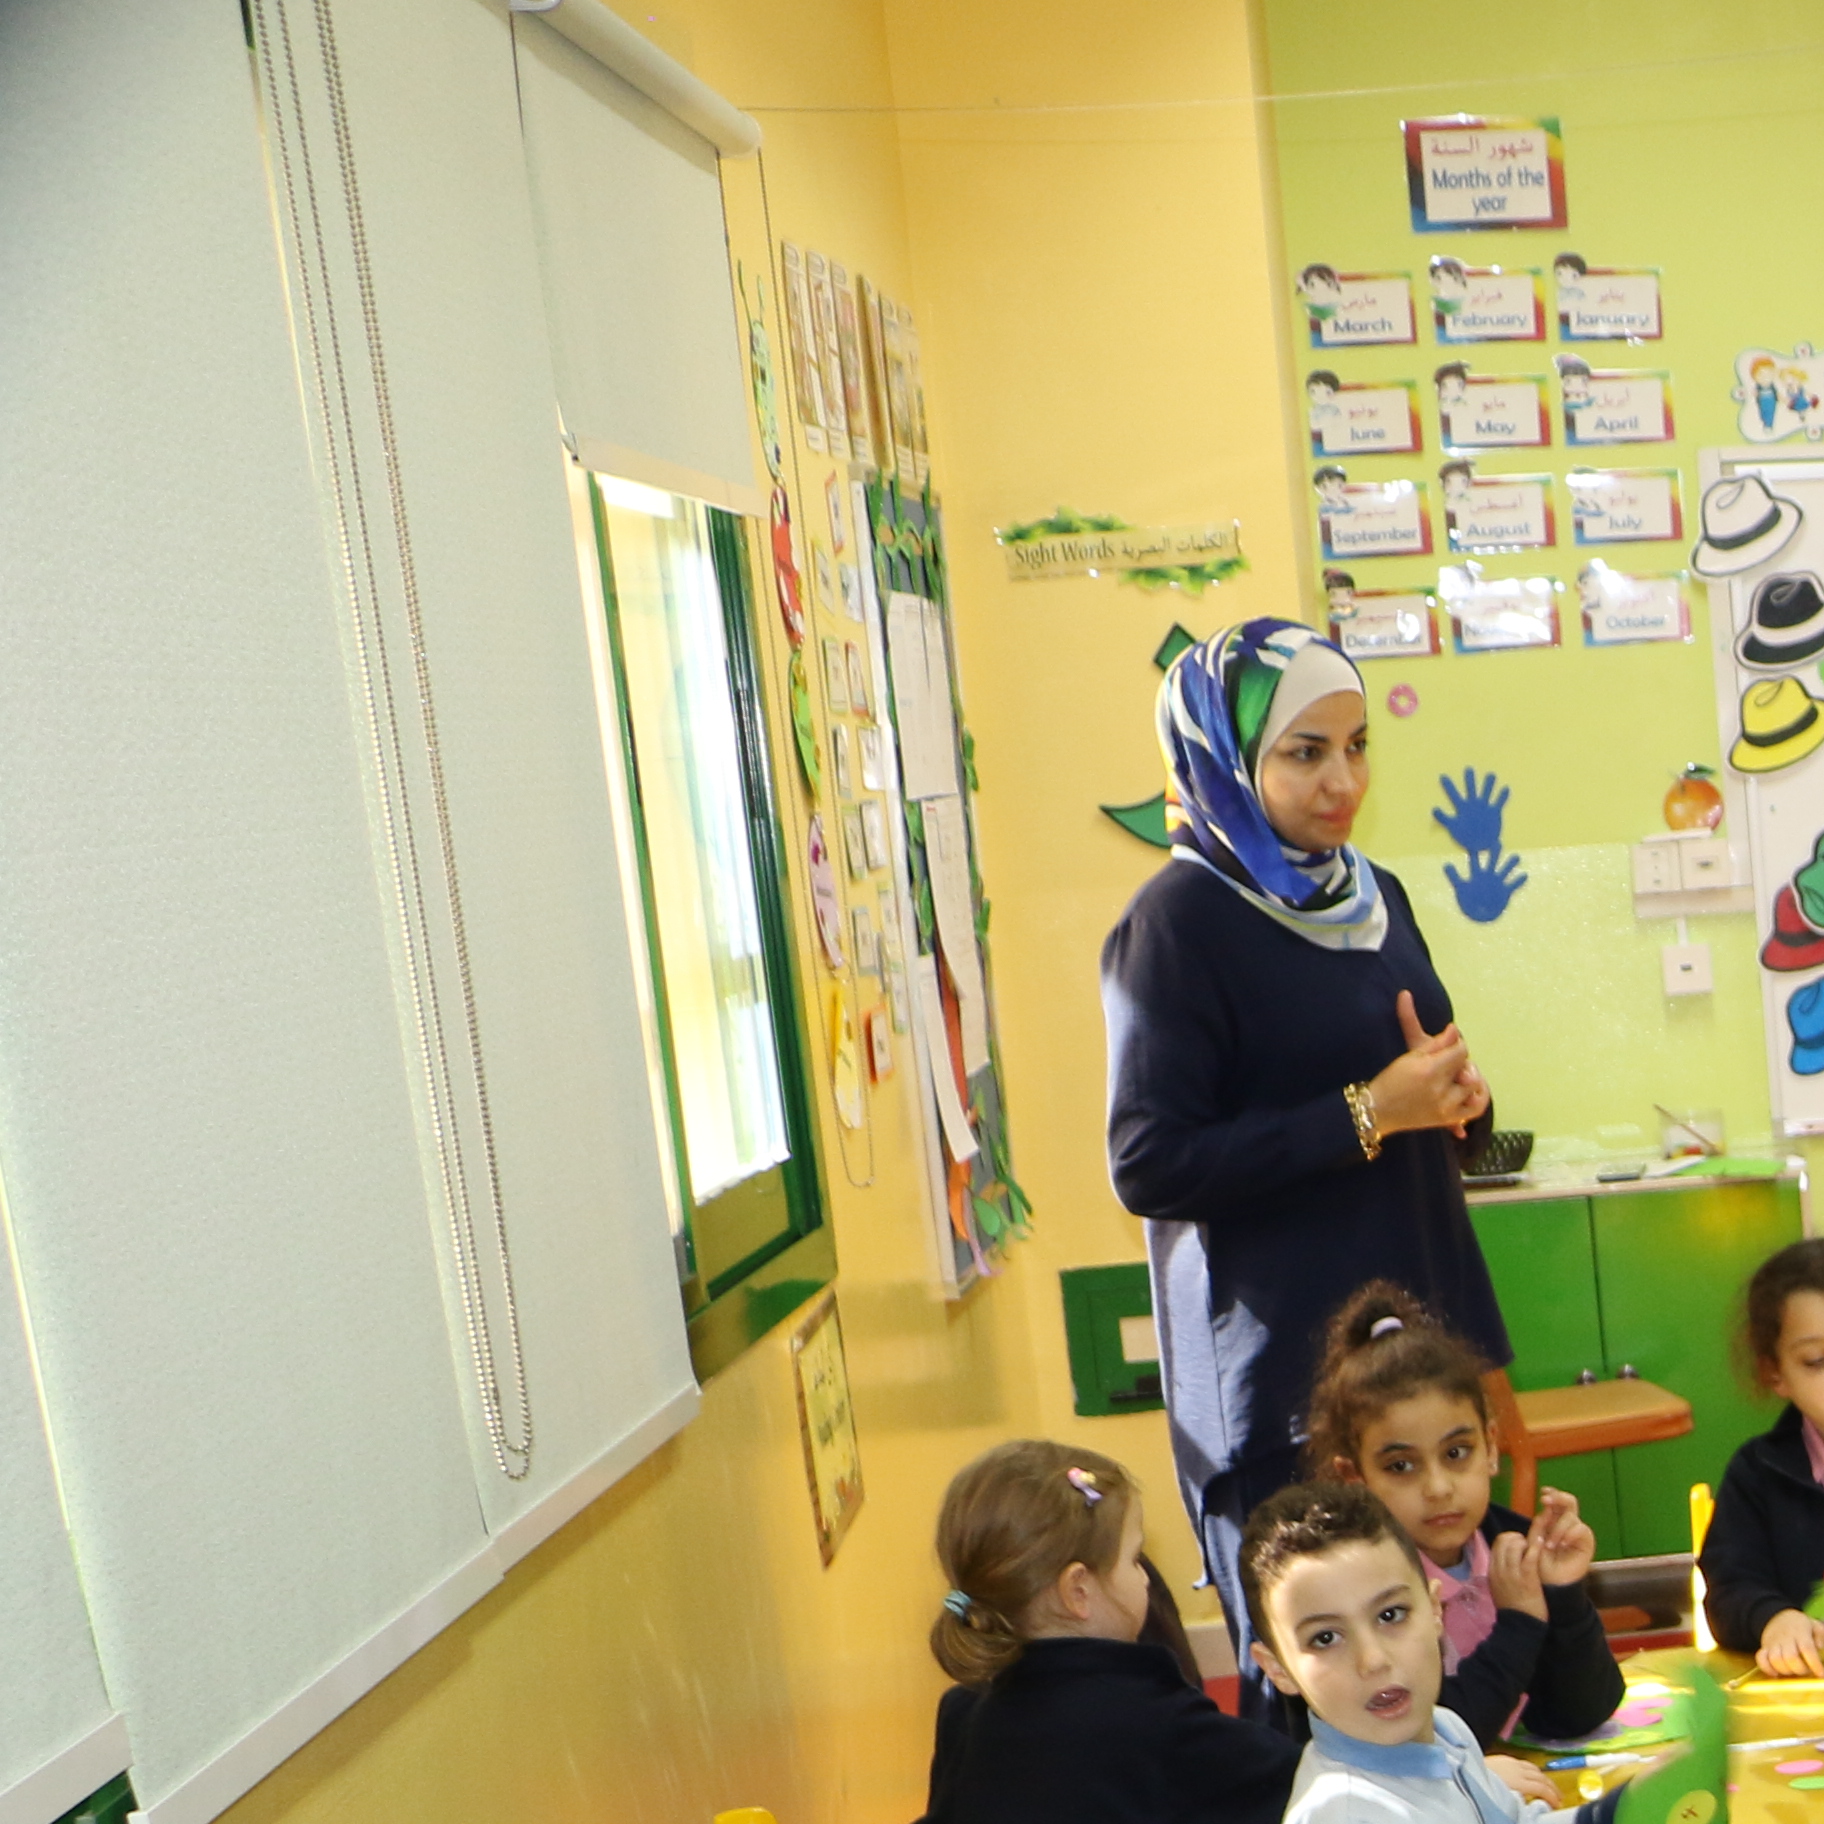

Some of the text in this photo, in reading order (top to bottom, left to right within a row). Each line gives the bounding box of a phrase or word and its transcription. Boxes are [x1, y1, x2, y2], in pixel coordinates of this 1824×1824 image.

[1431, 135, 1533, 160] شهور السنة
[1432, 166, 1544, 189] Months of the
[1472, 194, 1507, 215] year
[1333, 317, 1393, 333] March
[1451, 312, 1527, 330] February
[1576, 311, 1649, 328] January
[1350, 426, 1386, 441] June
[1475, 419, 1516, 436] May
[1594, 415, 1639, 434] April
[1467, 522, 1531, 540] August
[1607, 515, 1643, 532] July
[1333, 527, 1418, 545] September
[1014, 537, 1115, 570] Sight Words
[1606, 614, 1665, 630] October
